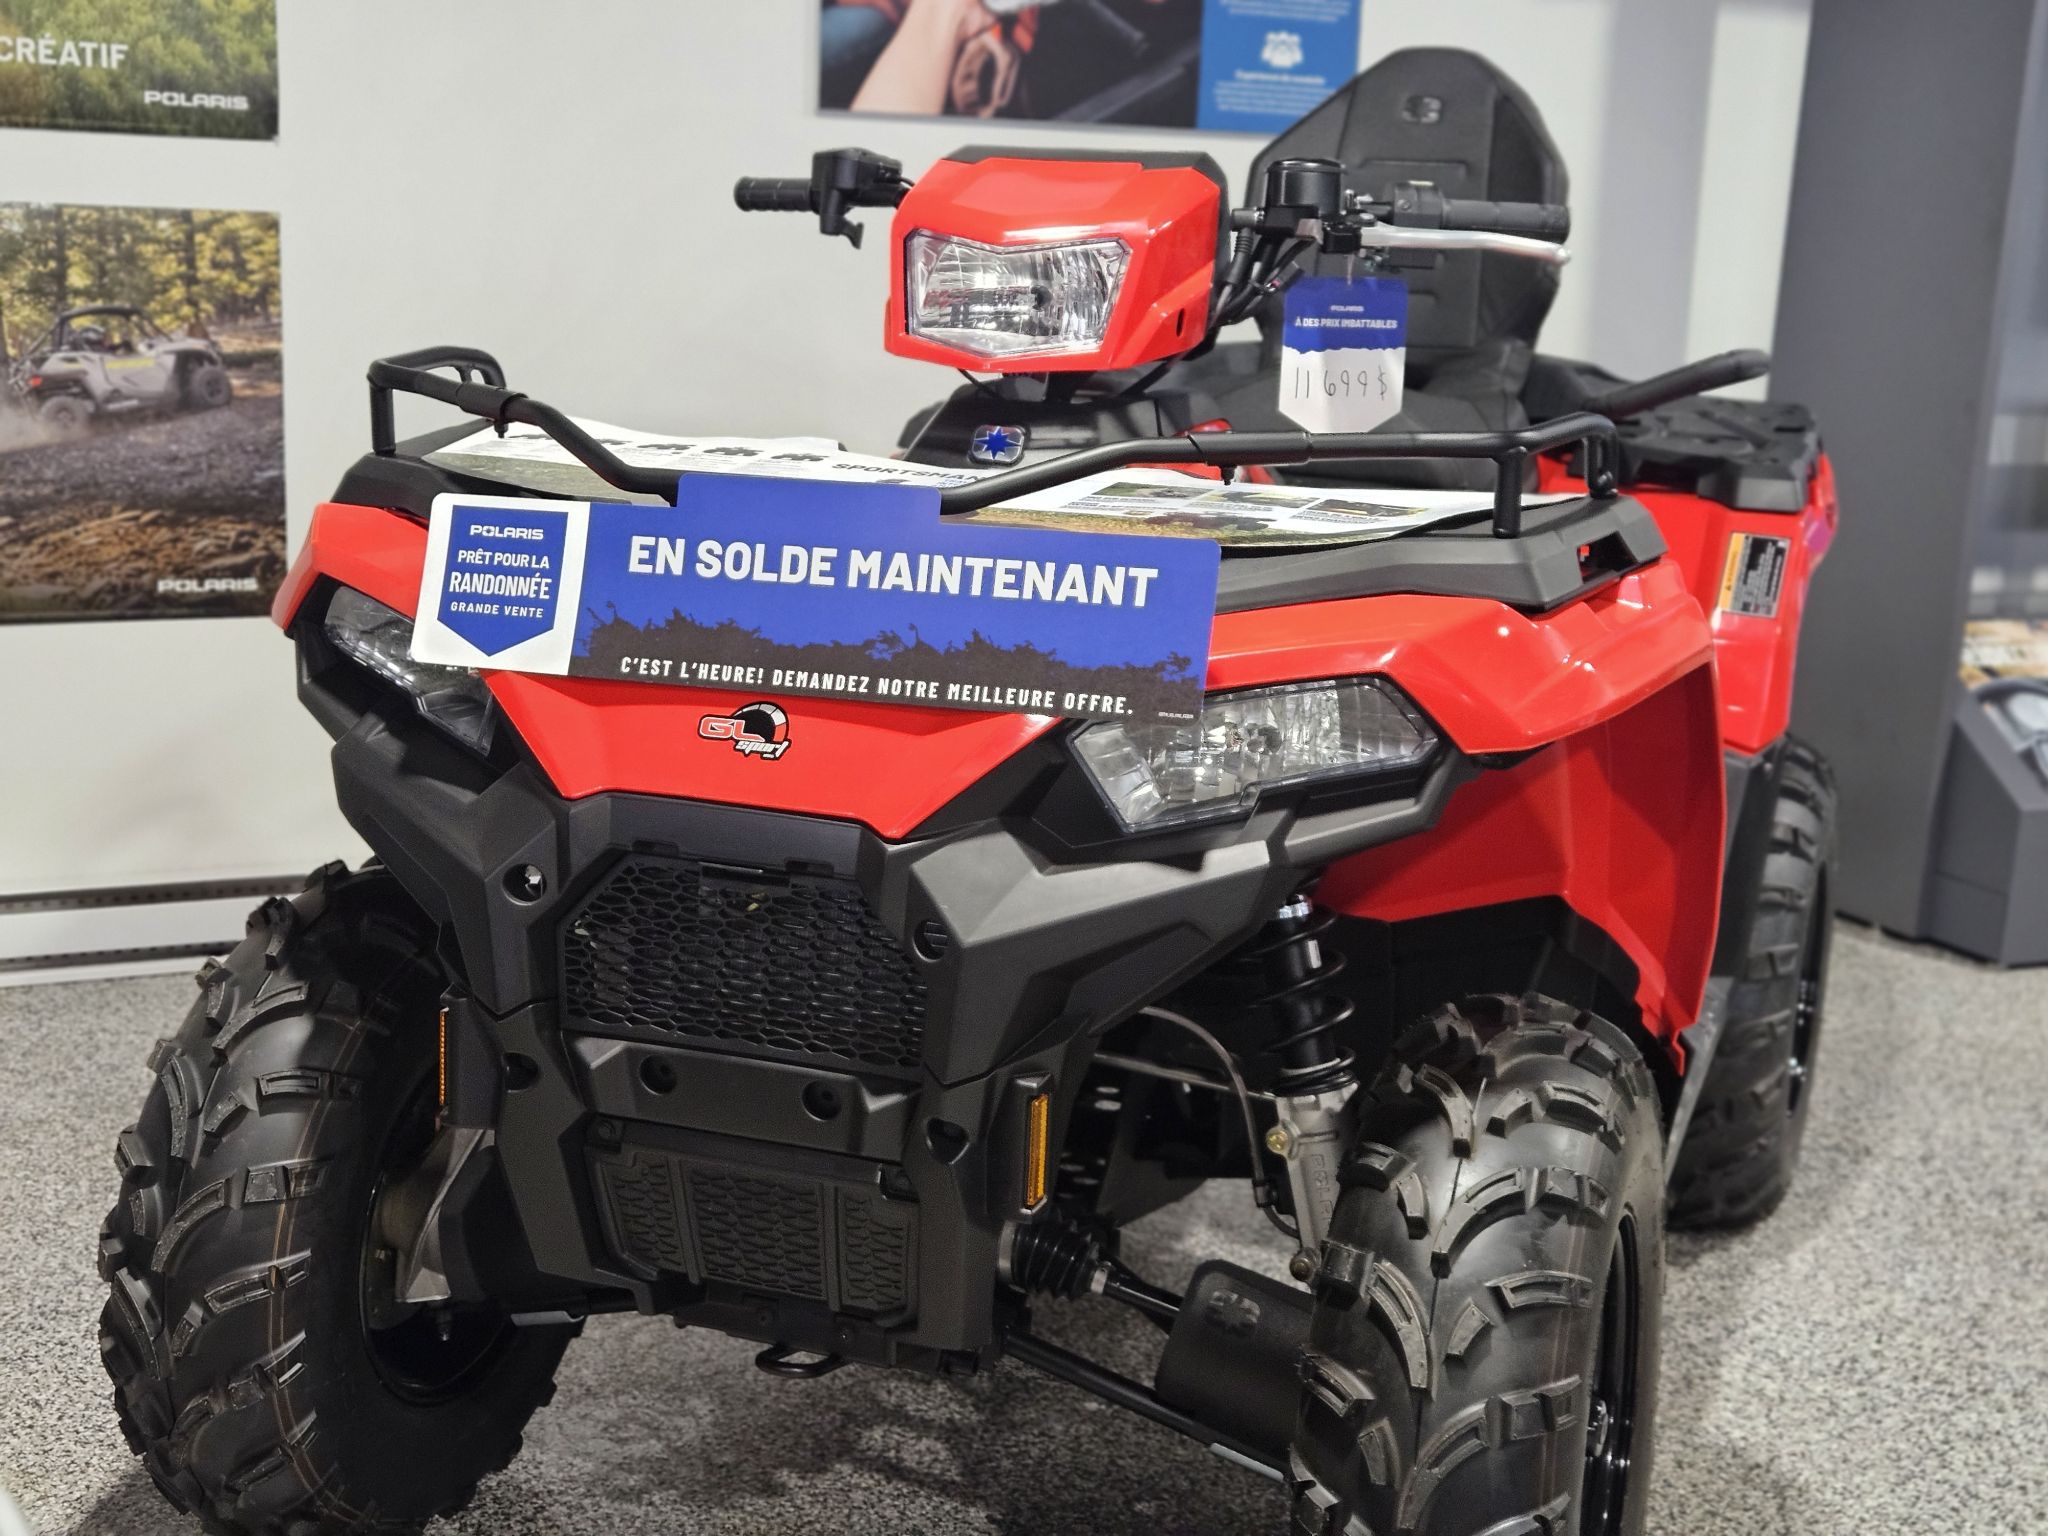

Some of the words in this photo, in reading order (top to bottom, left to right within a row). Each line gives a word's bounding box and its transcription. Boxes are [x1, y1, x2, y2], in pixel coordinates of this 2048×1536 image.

[144, 90, 249, 110] POLARIS
[1303, 317, 1320, 327] DES
[1320, 318, 1341, 328] PRIX
[1341, 318, 1398, 329] IMBATTABLES
[470, 524, 544, 540] POLARIS
[457, 548, 493, 565] PRÊT
[493, 552, 529, 568] POUR
[531, 555, 550, 569] LA
[628, 535, 686, 576] EN
[695, 539, 838, 586] SOLDE
[847, 549, 1159, 607] MAINTENANT
[157, 577, 258, 593] POLARIS
[449, 571, 553, 599] RANDONNÉE
[450, 601, 500, 615] GRANDE
[504, 605, 544, 618] VENTE
[620, 656, 673, 676] C'EST
[680, 661, 764, 684] L'HEURE!
[772, 669, 870, 693] DEMANDEZ
[877, 677, 940, 699] NOTRE
[948, 683, 1055, 708] MEILLEURE
[1063, 692, 1134, 715] OFFRE.
[699, 716, 766, 743] GL
